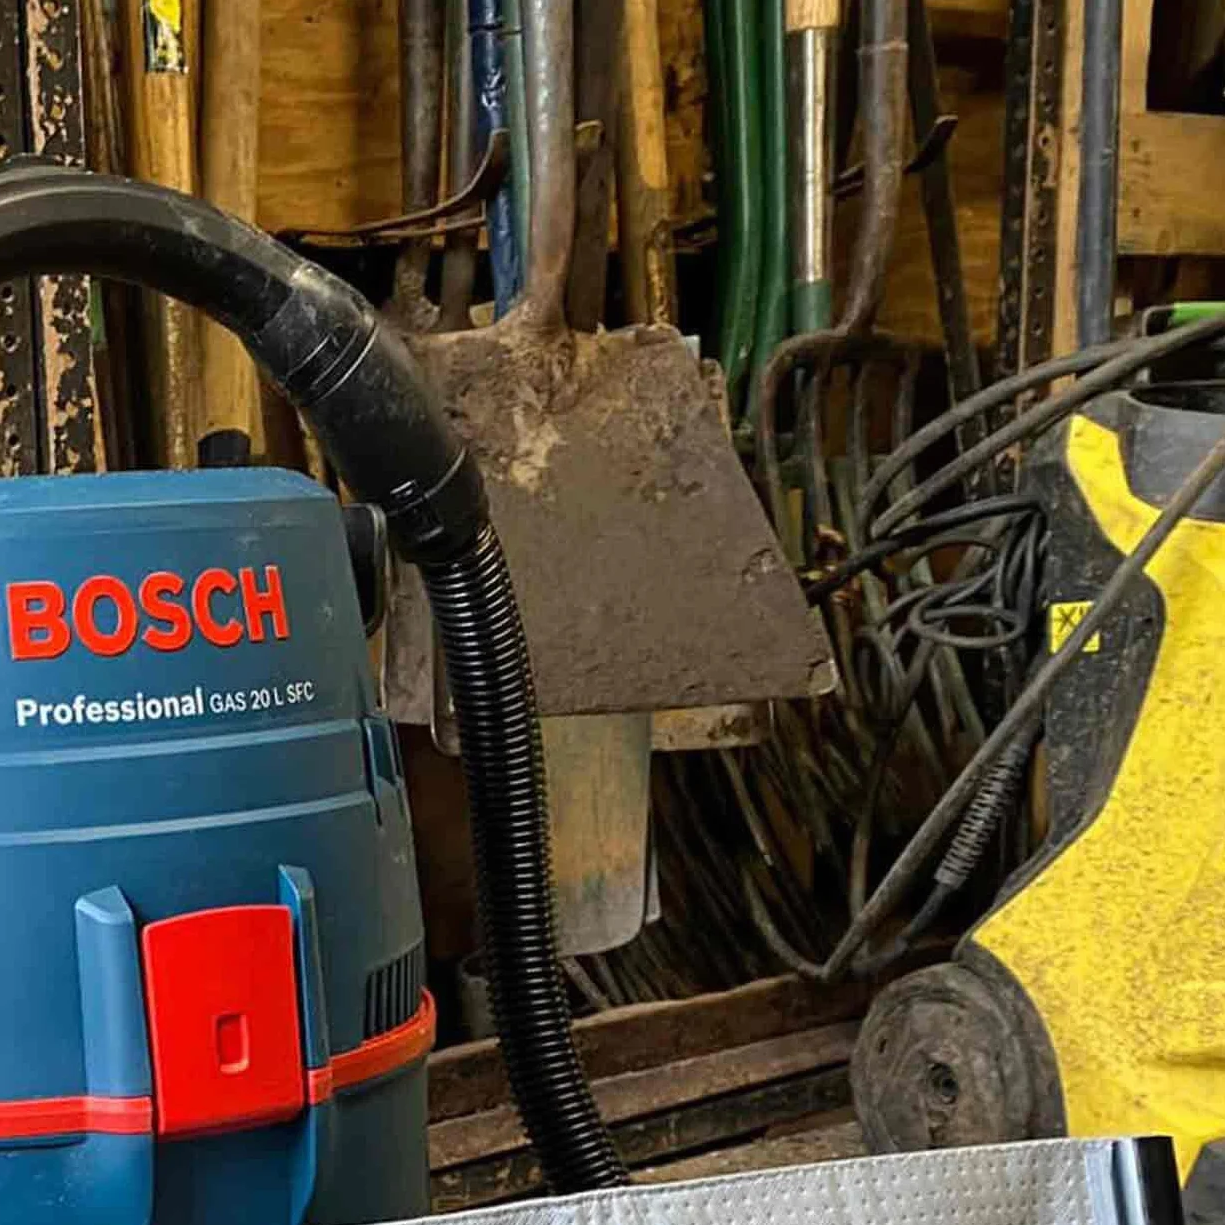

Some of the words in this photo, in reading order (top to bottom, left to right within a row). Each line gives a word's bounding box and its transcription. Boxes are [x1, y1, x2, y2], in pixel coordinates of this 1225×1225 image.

[6, 564, 290, 661] BOSCH
[15, 686, 204, 727] Professional
[209, 692, 247, 713] GAS
[250, 687, 271, 709] 20
[274, 686, 284, 706] L
[286, 680, 315, 704] SFC
